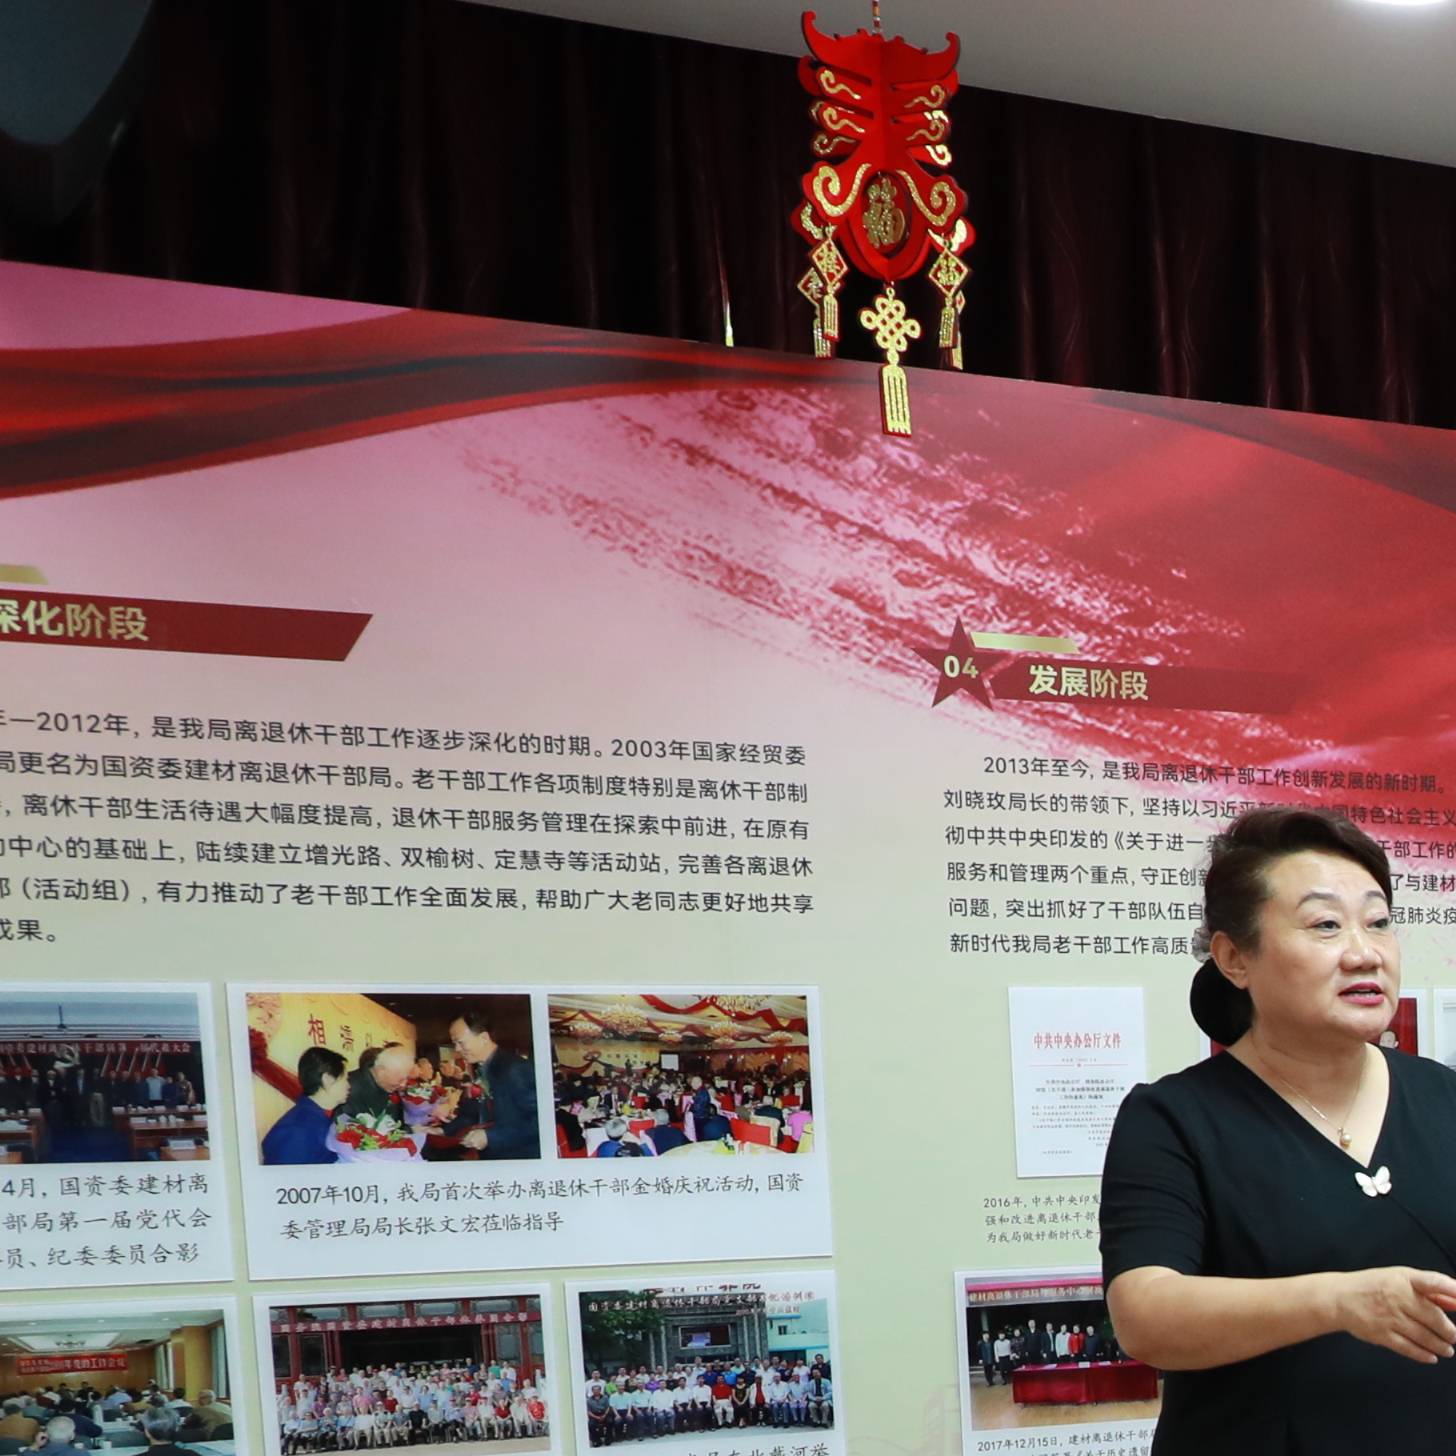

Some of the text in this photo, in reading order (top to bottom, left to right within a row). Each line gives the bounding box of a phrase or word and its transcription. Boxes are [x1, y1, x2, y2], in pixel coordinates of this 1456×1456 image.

[943, 655, 979, 680] 04
[1028, 664, 1149, 700] 发展阶段
[0, 709, 807, 766] —2012年，是我局离退休干部工作逐步深化的时期。2003年国家经贸委
[0, 794, 809, 840] ，离休干部生活待遇大幅度提高，退休干部服务管理在探索中前进，在原有
[0, 837, 813, 877] 中心的基础上，陆续建立增光路、双榆树、定慧寺等活动站，完善各离退休
[1033, 1032, 1122, 1049] 中共中央办公厅文件
[2, 1207, 213, 1233] 部局第一届党代会
[281, 1212, 564, 1241] 委管理局局长张文宏莅临指导
[987, 1229, 1101, 1243] 为我局做好新时代老
[0, 1242, 200, 1270] 员、纪委委员合影
